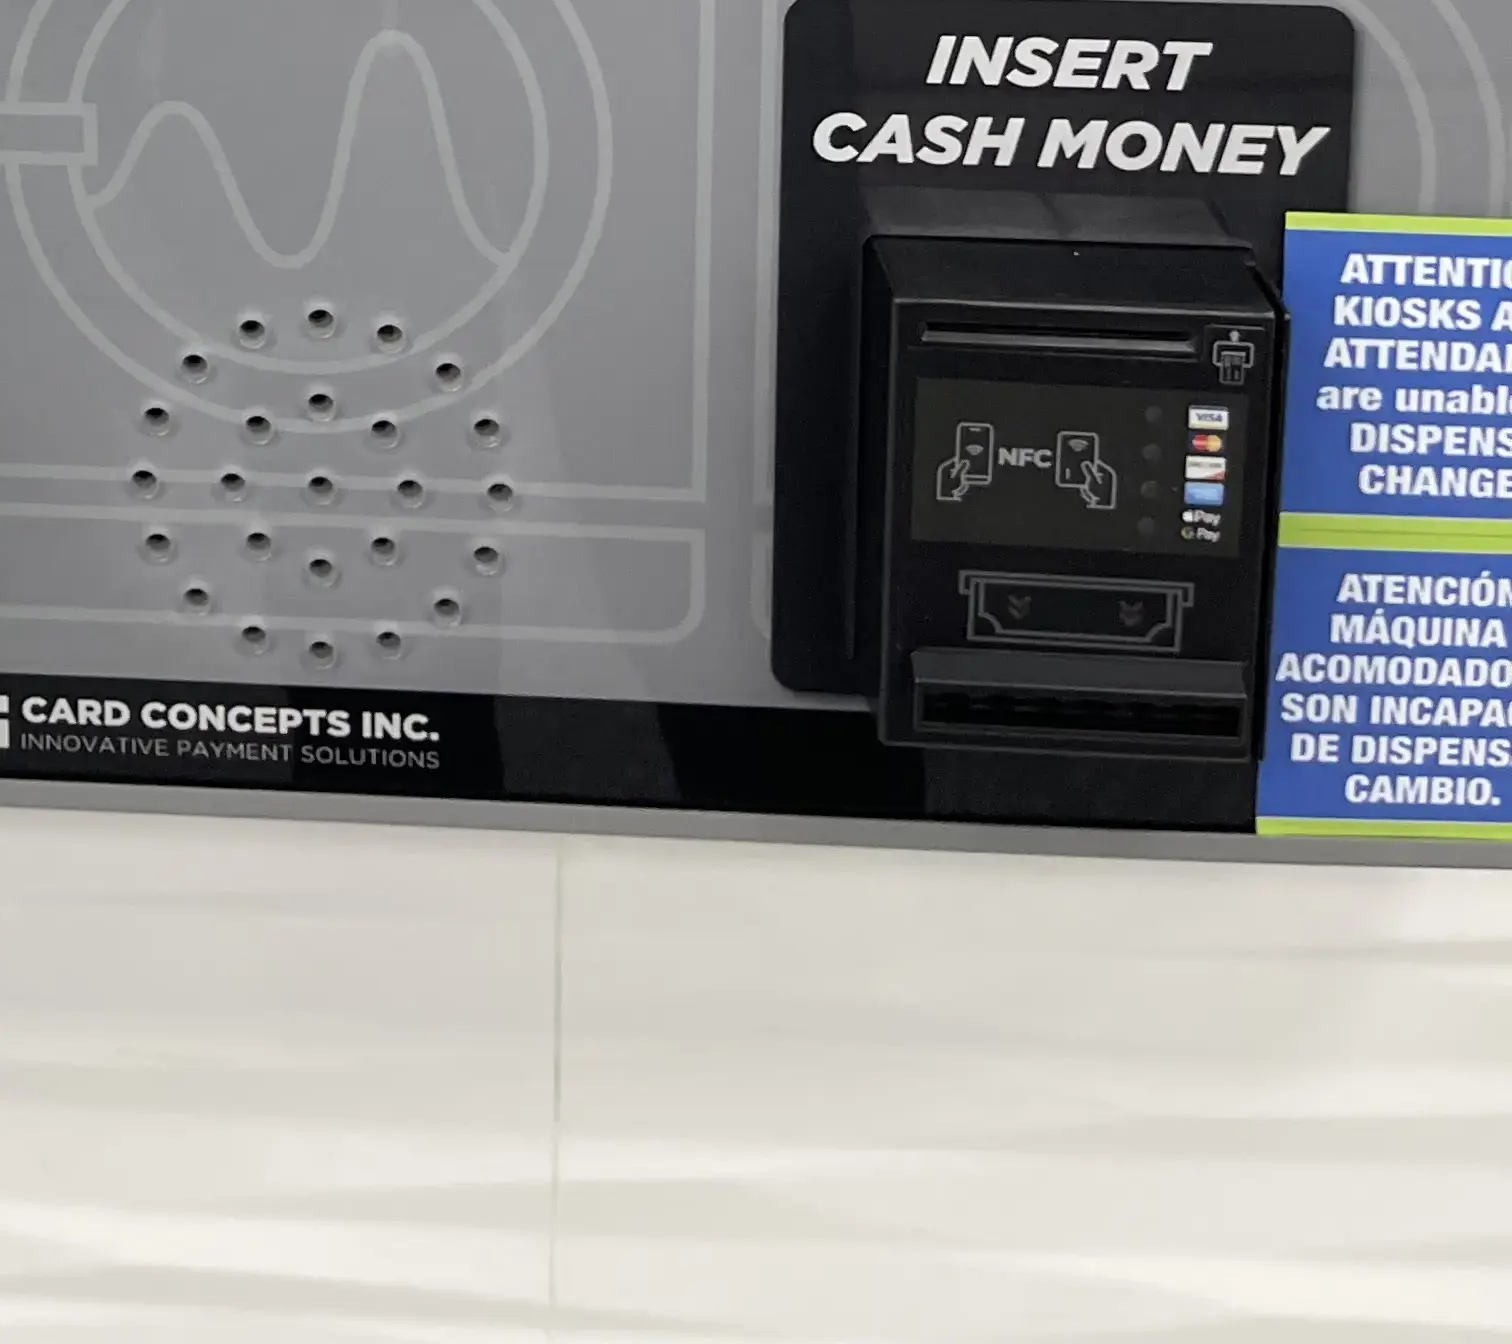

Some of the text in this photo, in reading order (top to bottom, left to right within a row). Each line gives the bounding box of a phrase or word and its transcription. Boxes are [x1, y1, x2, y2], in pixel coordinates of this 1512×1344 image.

[926, 34, 1214, 92] INSERT
[811, 111, 1331, 177] CASH MONEY
[1333, 295, 1482, 331] KIOSKS
[1316, 384, 1512, 416] are unabl
[997, 447, 1053, 469] NFC
[1330, 608, 1508, 649] MÁQUINA
[21, 696, 441, 743] CARD CONCEPTS INC.
[1280, 693, 1512, 728] SON INCAPA
[20, 732, 441, 771] INNOVATIVE PAYMENT SOLUTIONS
[1290, 732, 1512, 768] DE DISPENS
[1344, 774, 1502, 806] CAMBIO.
